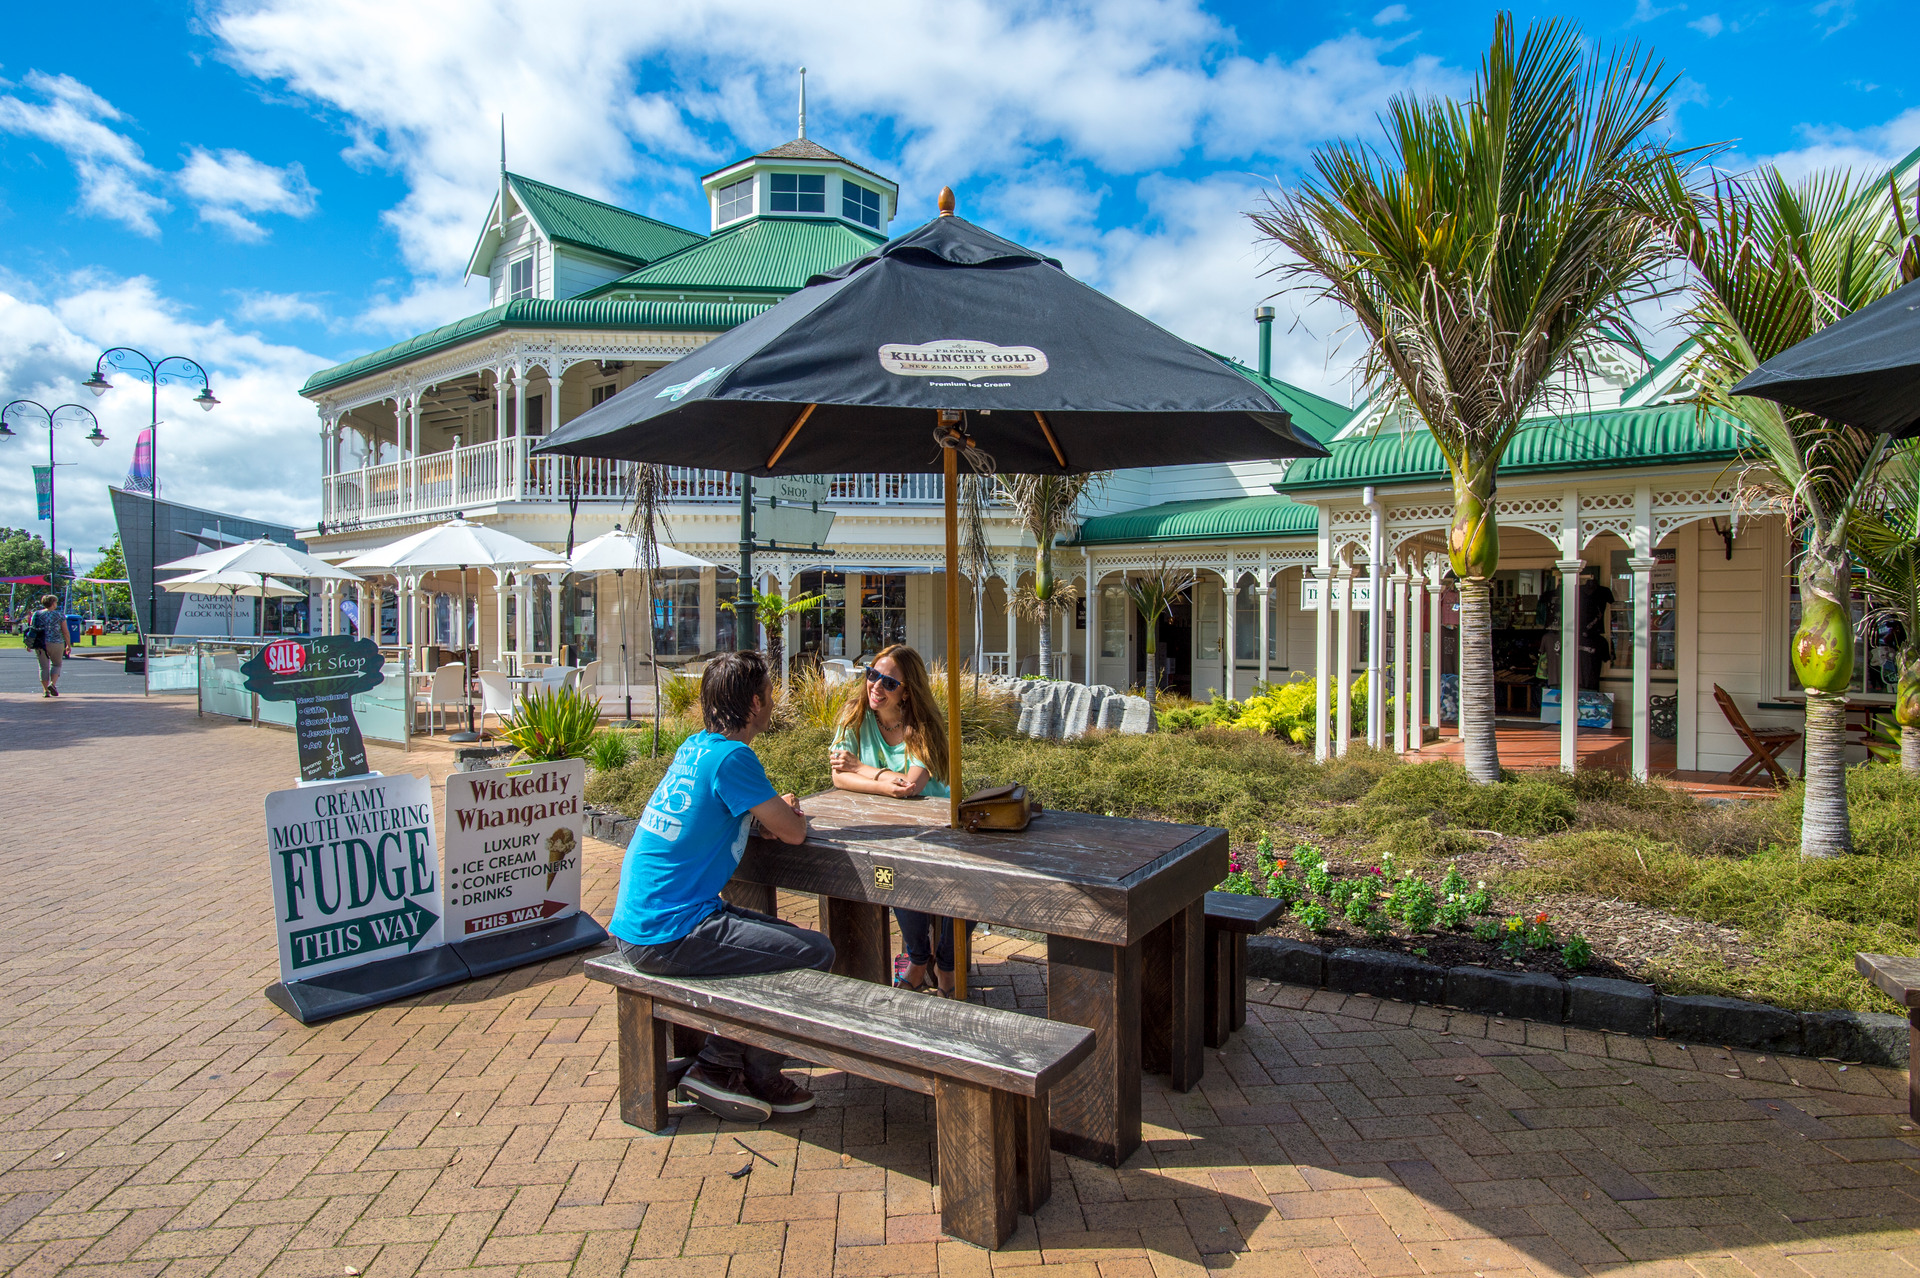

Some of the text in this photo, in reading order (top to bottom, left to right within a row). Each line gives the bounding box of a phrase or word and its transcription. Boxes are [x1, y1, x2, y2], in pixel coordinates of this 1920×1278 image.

[890, 351, 1037, 363] KILLINCHY GOLD
[184, 610, 212, 618] CLOCK
[268, 644, 300, 671] SALE
[327, 653, 366, 674] Shop
[297, 692, 349, 705] New Zealand
[303, 705, 326, 715] Gifts
[305, 714, 349, 727] Souvenirs
[306, 726, 350, 738] Jewellery
[308, 740, 323, 750] Art
[469, 771, 571, 803] Wickedly
[315, 786, 386, 818] CREAMY
[455, 795, 578, 832] Whangarei
[272, 803, 430, 850] MOUTH WATERING
[484, 833, 540, 854] LUXURY
[462, 850, 537, 874] ICE CREAM
[278, 826, 435, 923] FUDGE
[462, 857, 576, 890] CONFECTIONERY
[462, 885, 513, 906] DRINKS
[472, 905, 544, 931] THIS WAY
[295, 910, 422, 963] THIS WAY
